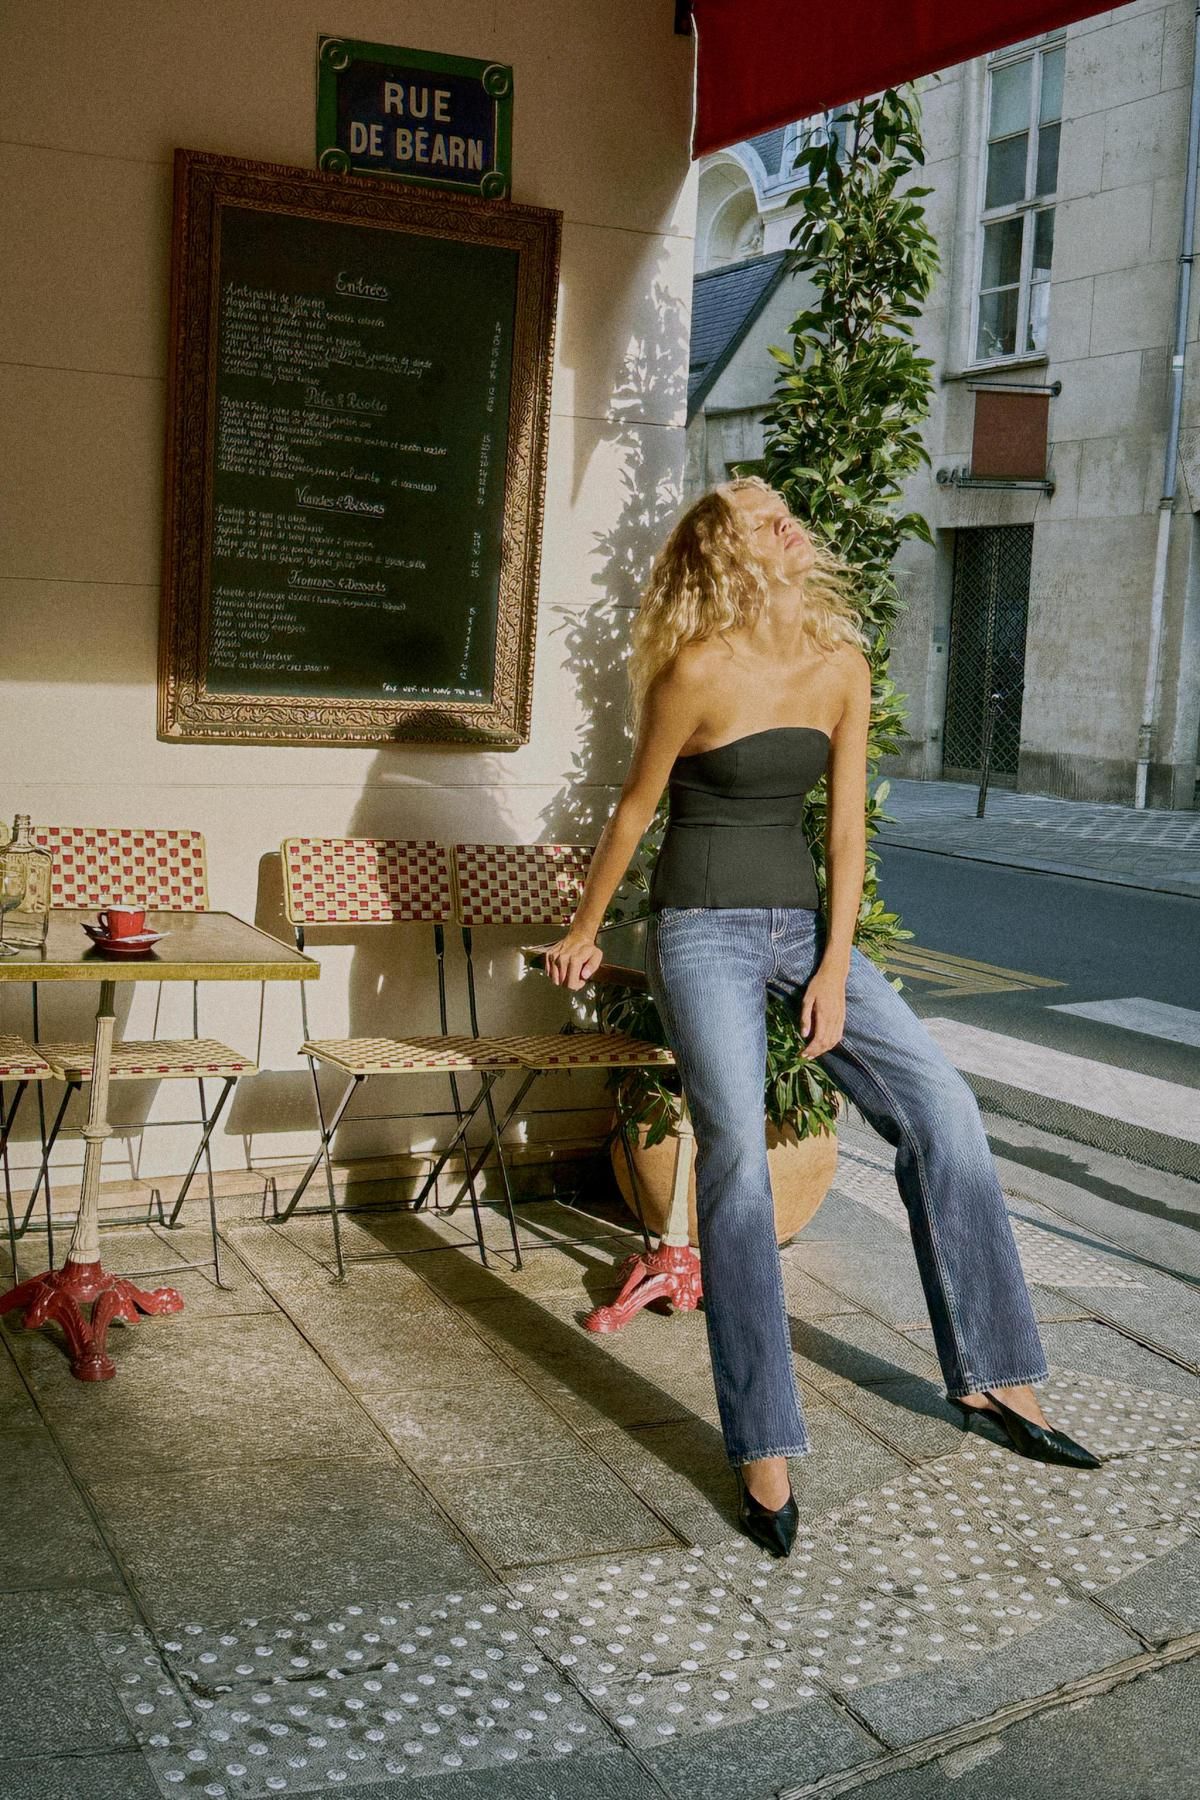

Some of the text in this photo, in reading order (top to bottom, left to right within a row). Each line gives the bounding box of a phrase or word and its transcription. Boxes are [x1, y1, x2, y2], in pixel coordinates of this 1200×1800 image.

[384, 81, 451, 123] RUE
[350, 121, 483, 171] DE BÉARN
[335, 271, 389, 298] Entrées
[295, 485, 334, 507] Viandes
